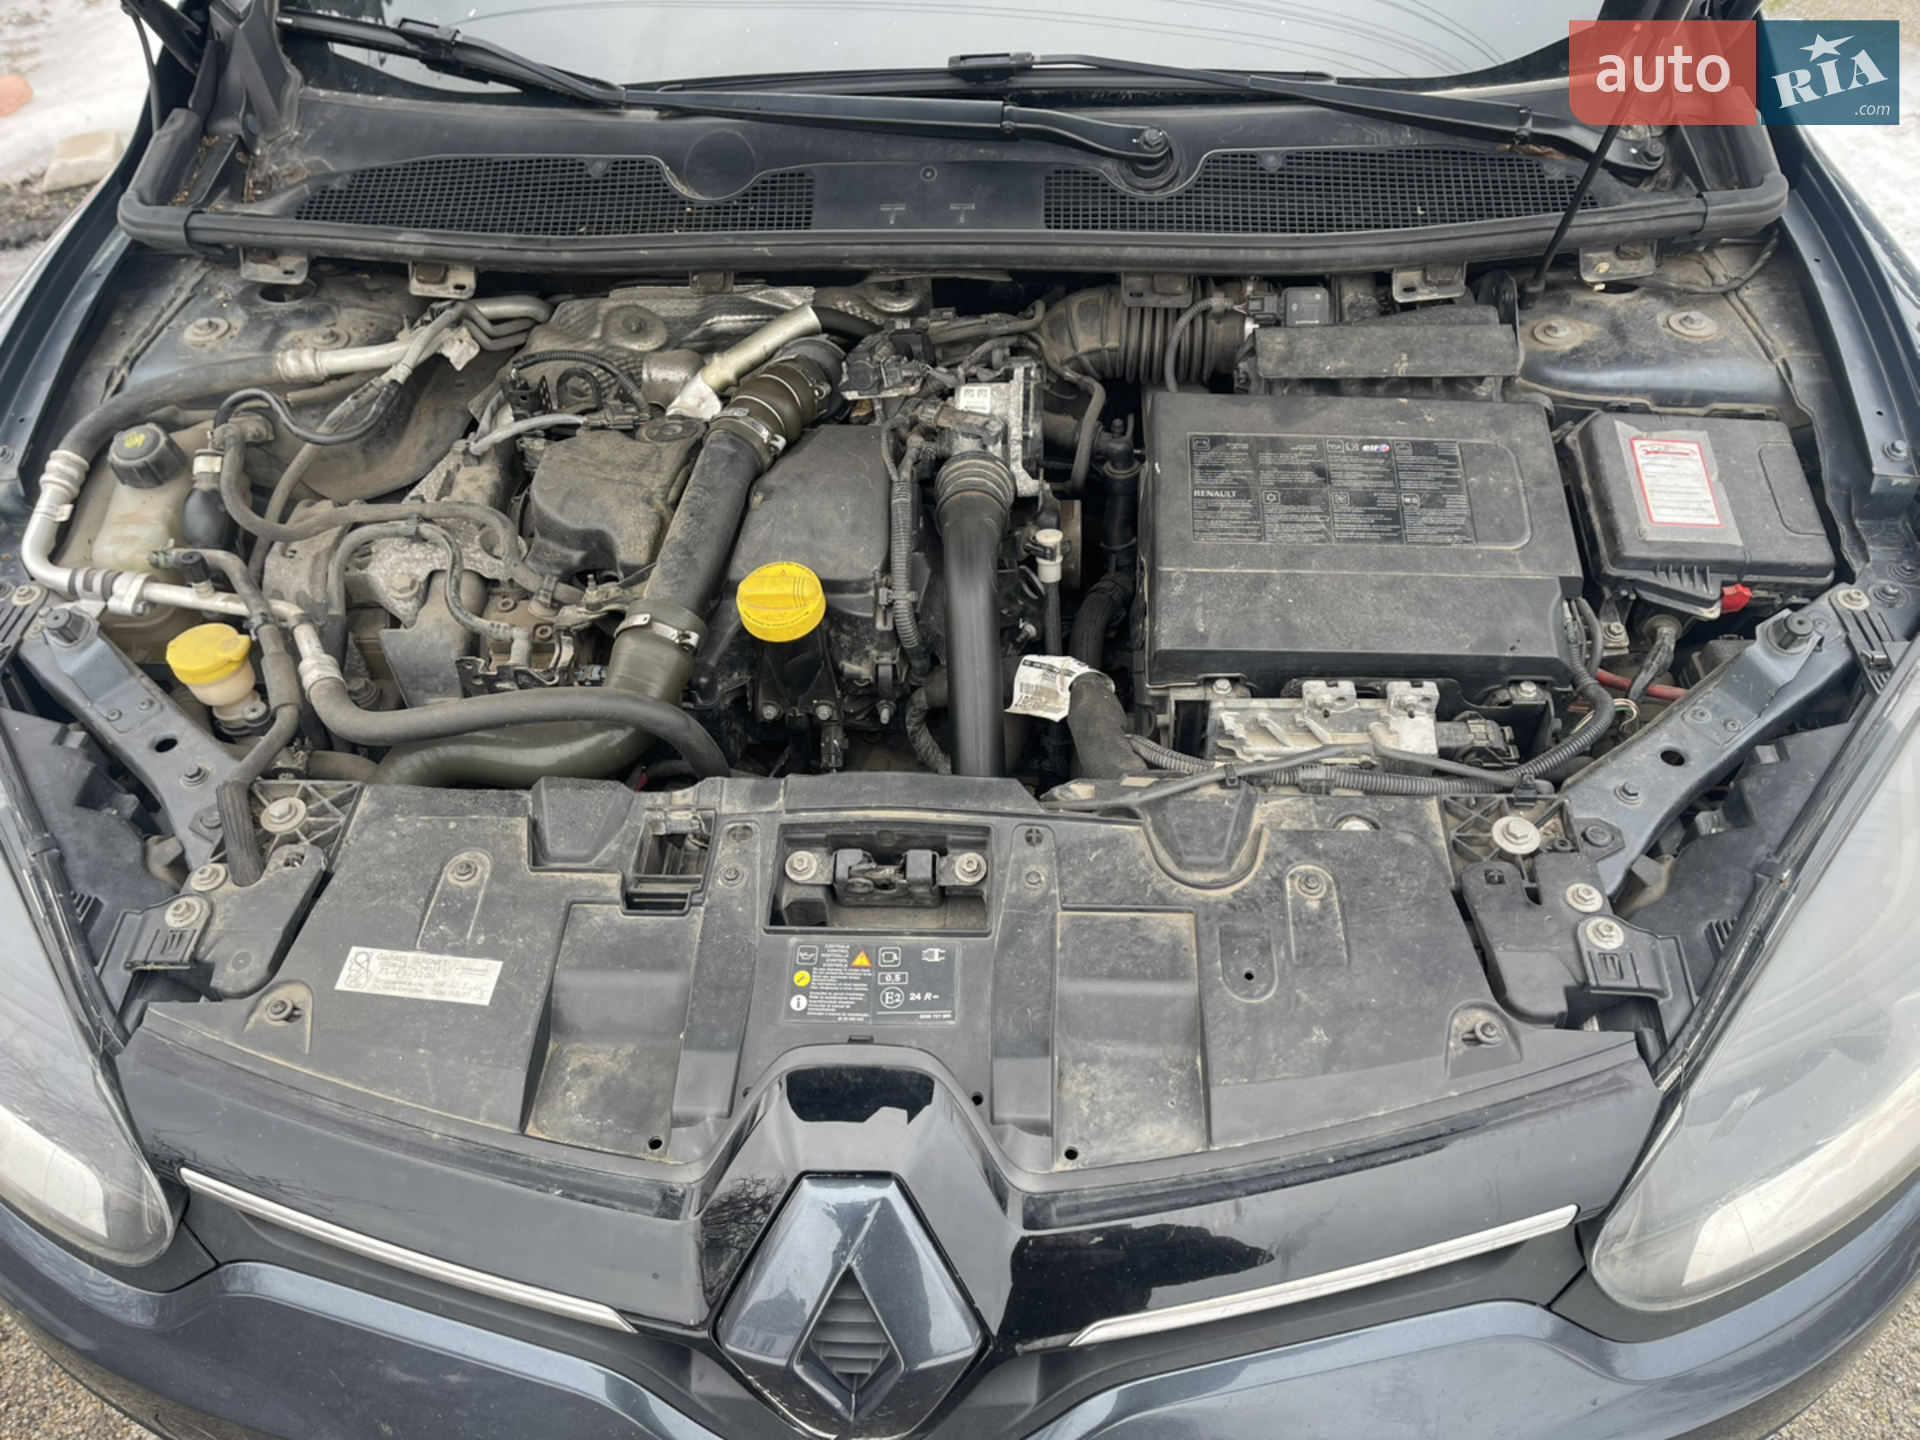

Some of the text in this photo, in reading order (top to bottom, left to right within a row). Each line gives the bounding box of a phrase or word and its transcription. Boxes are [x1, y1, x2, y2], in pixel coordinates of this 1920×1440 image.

[1193, 489, 1237, 498] RENAULT
[885, 973, 901, 983] 0,5
[909, 992, 922, 1001] 24
